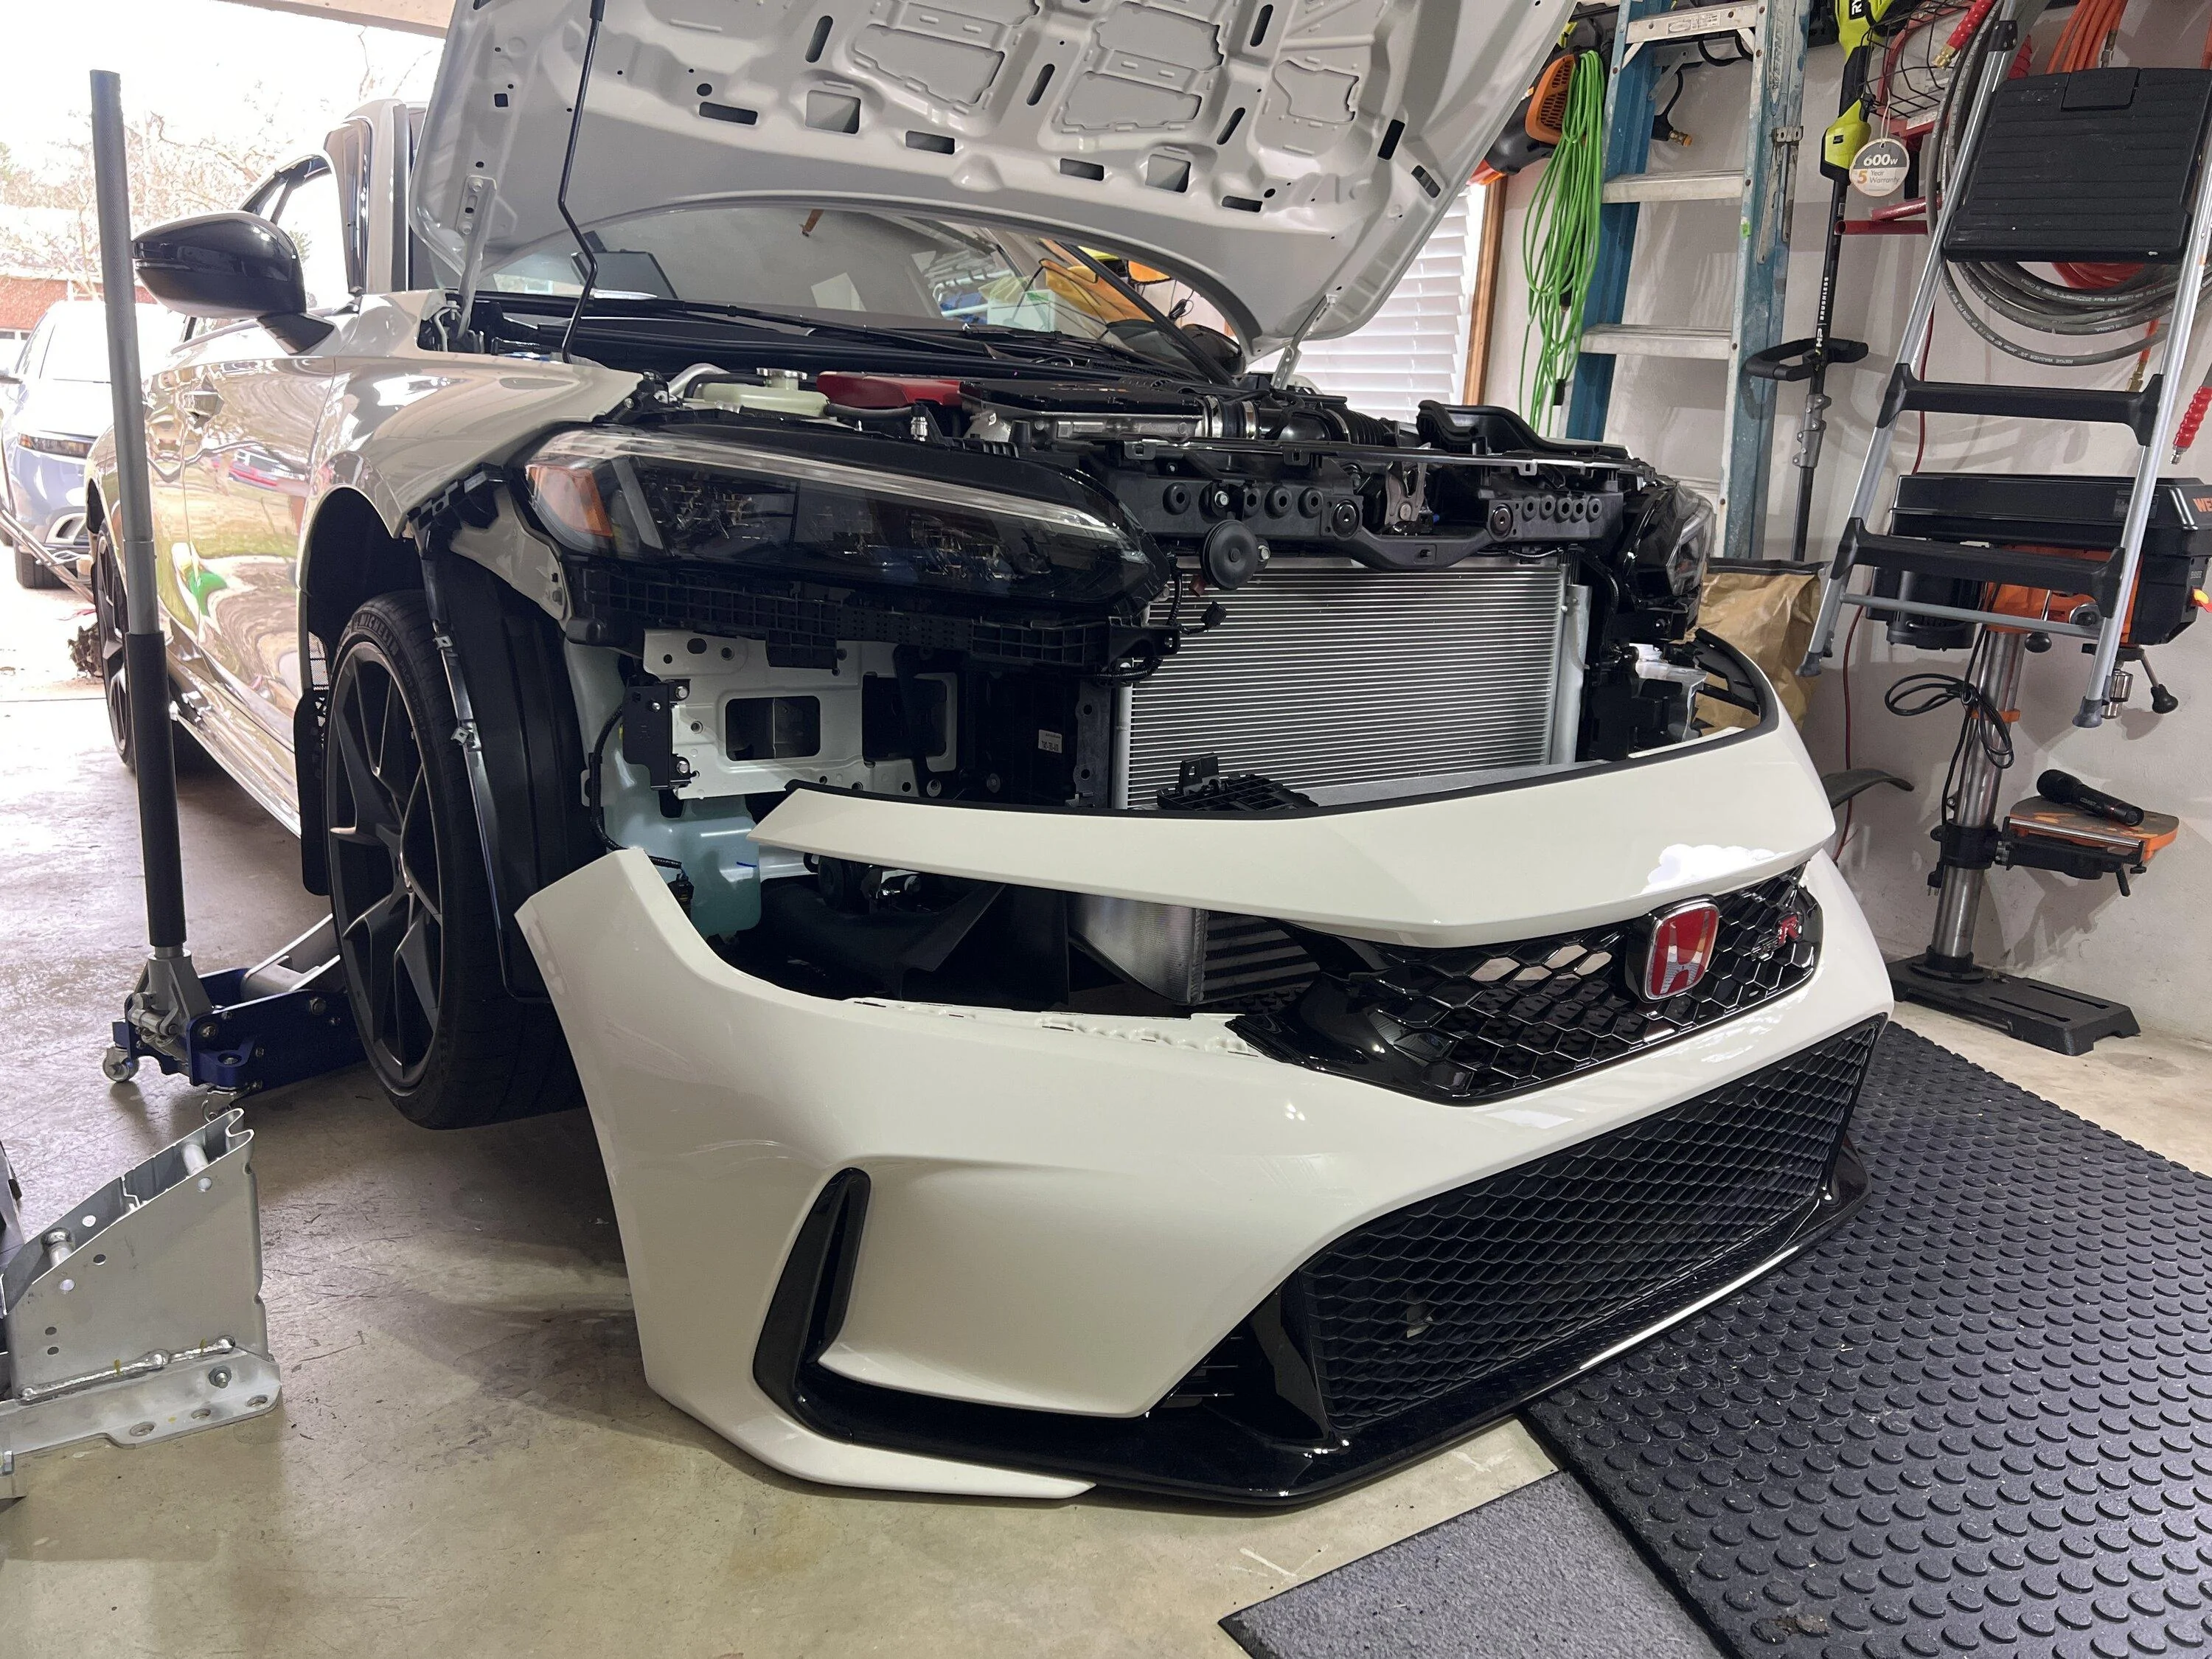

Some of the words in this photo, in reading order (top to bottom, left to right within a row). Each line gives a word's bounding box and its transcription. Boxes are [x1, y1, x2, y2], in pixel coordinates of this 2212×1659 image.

[1857, 170, 1868, 184] 5
[1870, 176, 1900, 185] Warranty
[1819, 276, 1829, 321] BRUSHLESS
[361, 613, 400, 656] MICHELIN
